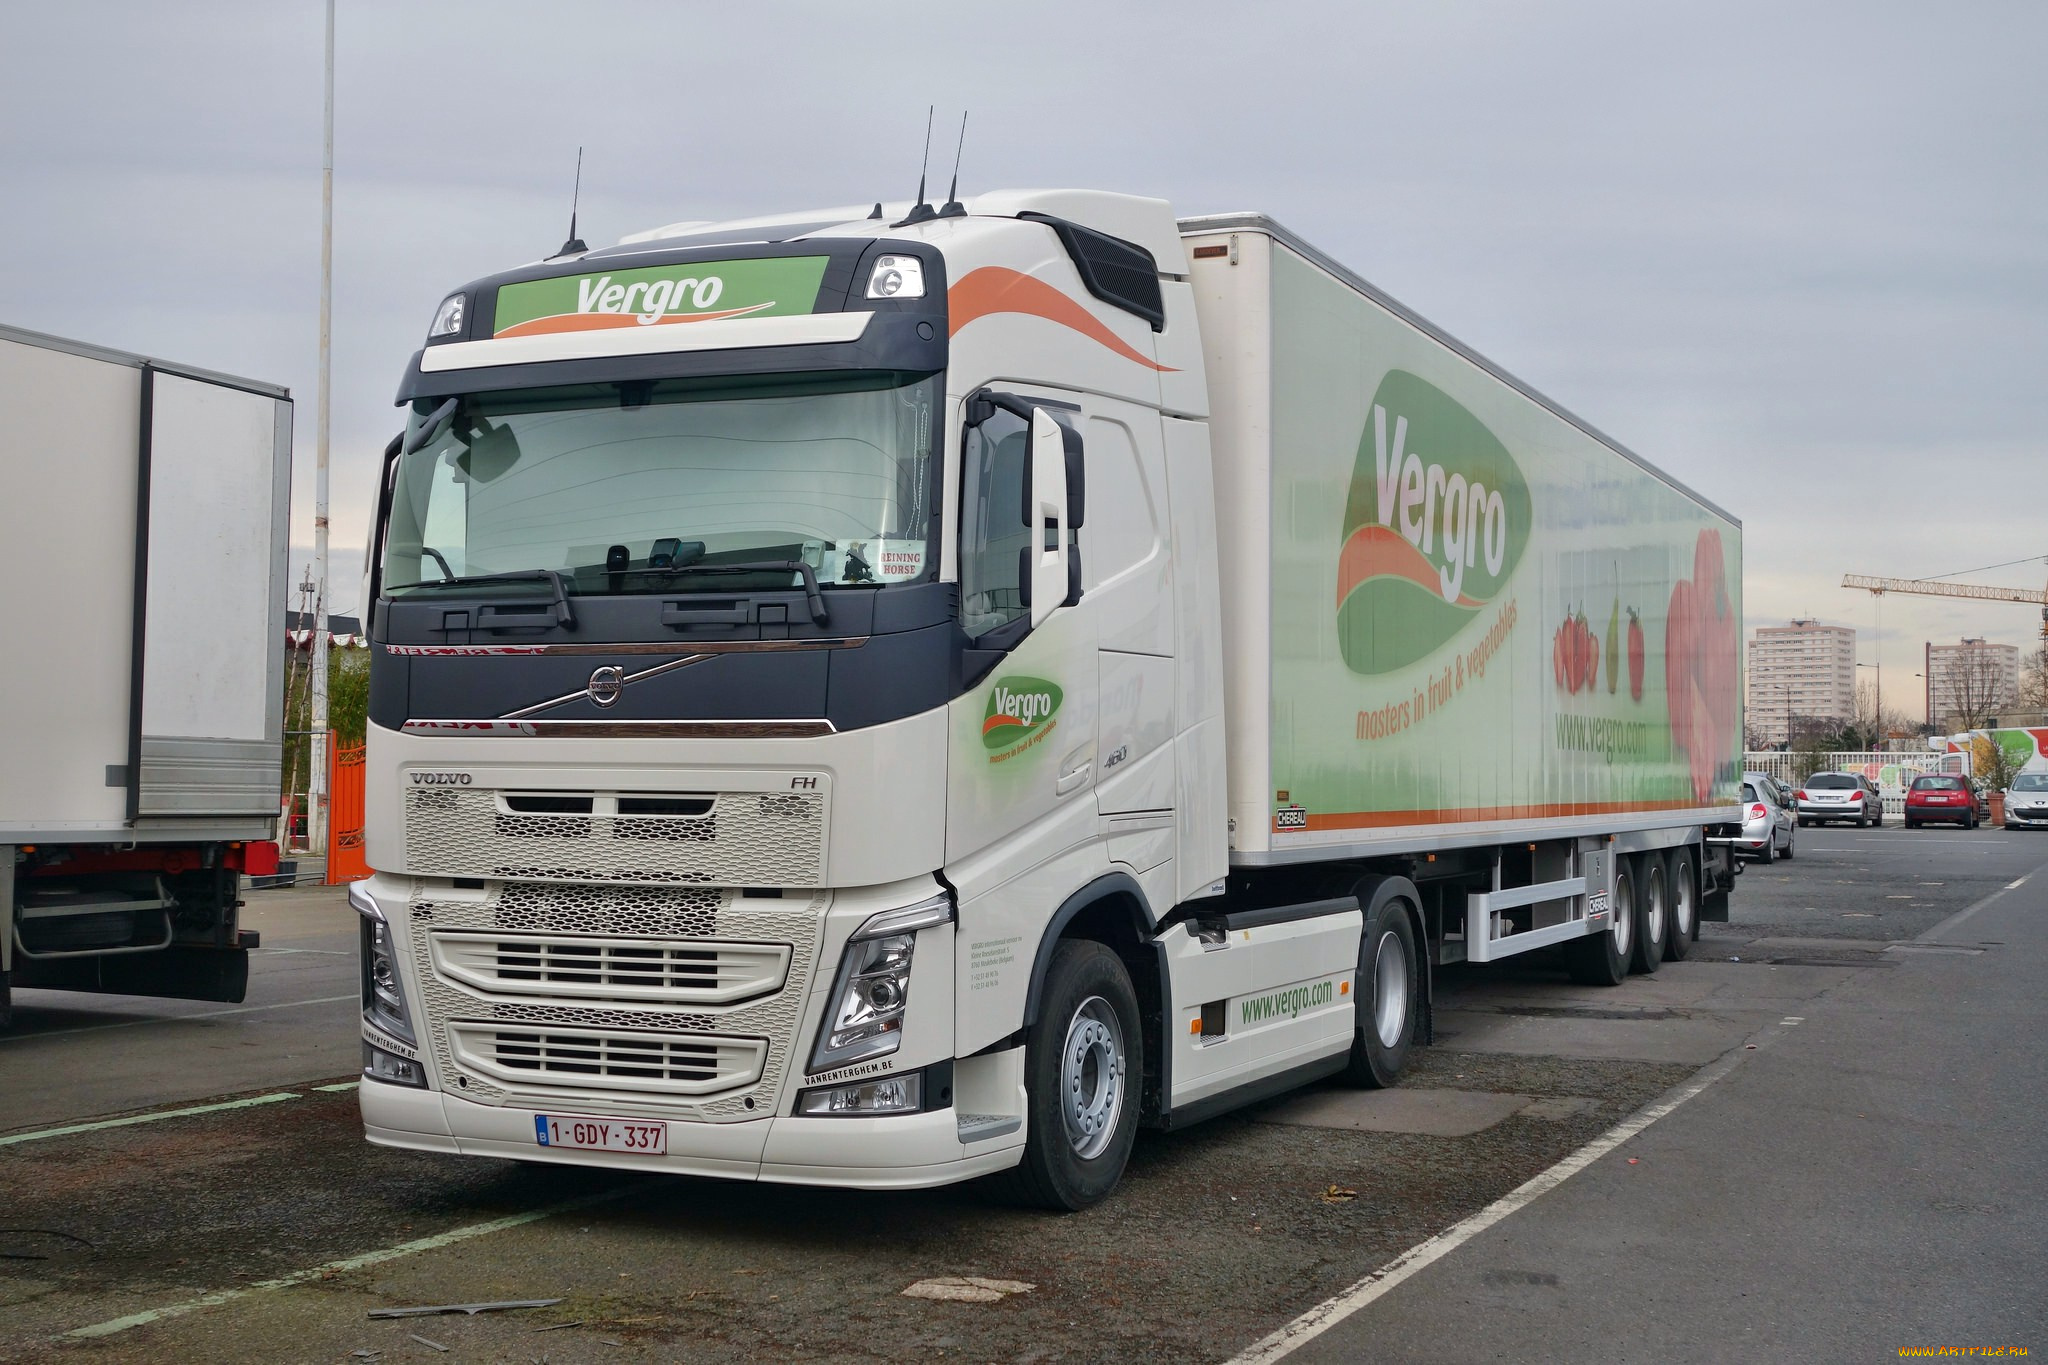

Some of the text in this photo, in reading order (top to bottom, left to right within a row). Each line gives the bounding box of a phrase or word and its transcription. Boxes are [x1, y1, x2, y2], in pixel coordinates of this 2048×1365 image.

[578, 276, 723, 325] Vergro
[1374, 403, 1506, 603] Vergro
[881, 552, 920, 563] REINING
[884, 565, 915, 575] HORSE
[1356, 598, 1517, 740] masters in fruit & vegetables
[994, 687, 1051, 726] Vergro
[1555, 712, 1646, 767] www.vergro.com
[1104, 745, 1127, 769] 460
[410, 773, 472, 784] VOLVO
[791, 777, 817, 789] FH
[1278, 811, 1305, 825] CHEREAU
[1242, 981, 1332, 1024] www.vergro.com
[804, 1060, 893, 1085] VANRENTERGHEM.BE
[539, 1132, 546, 1142] B
